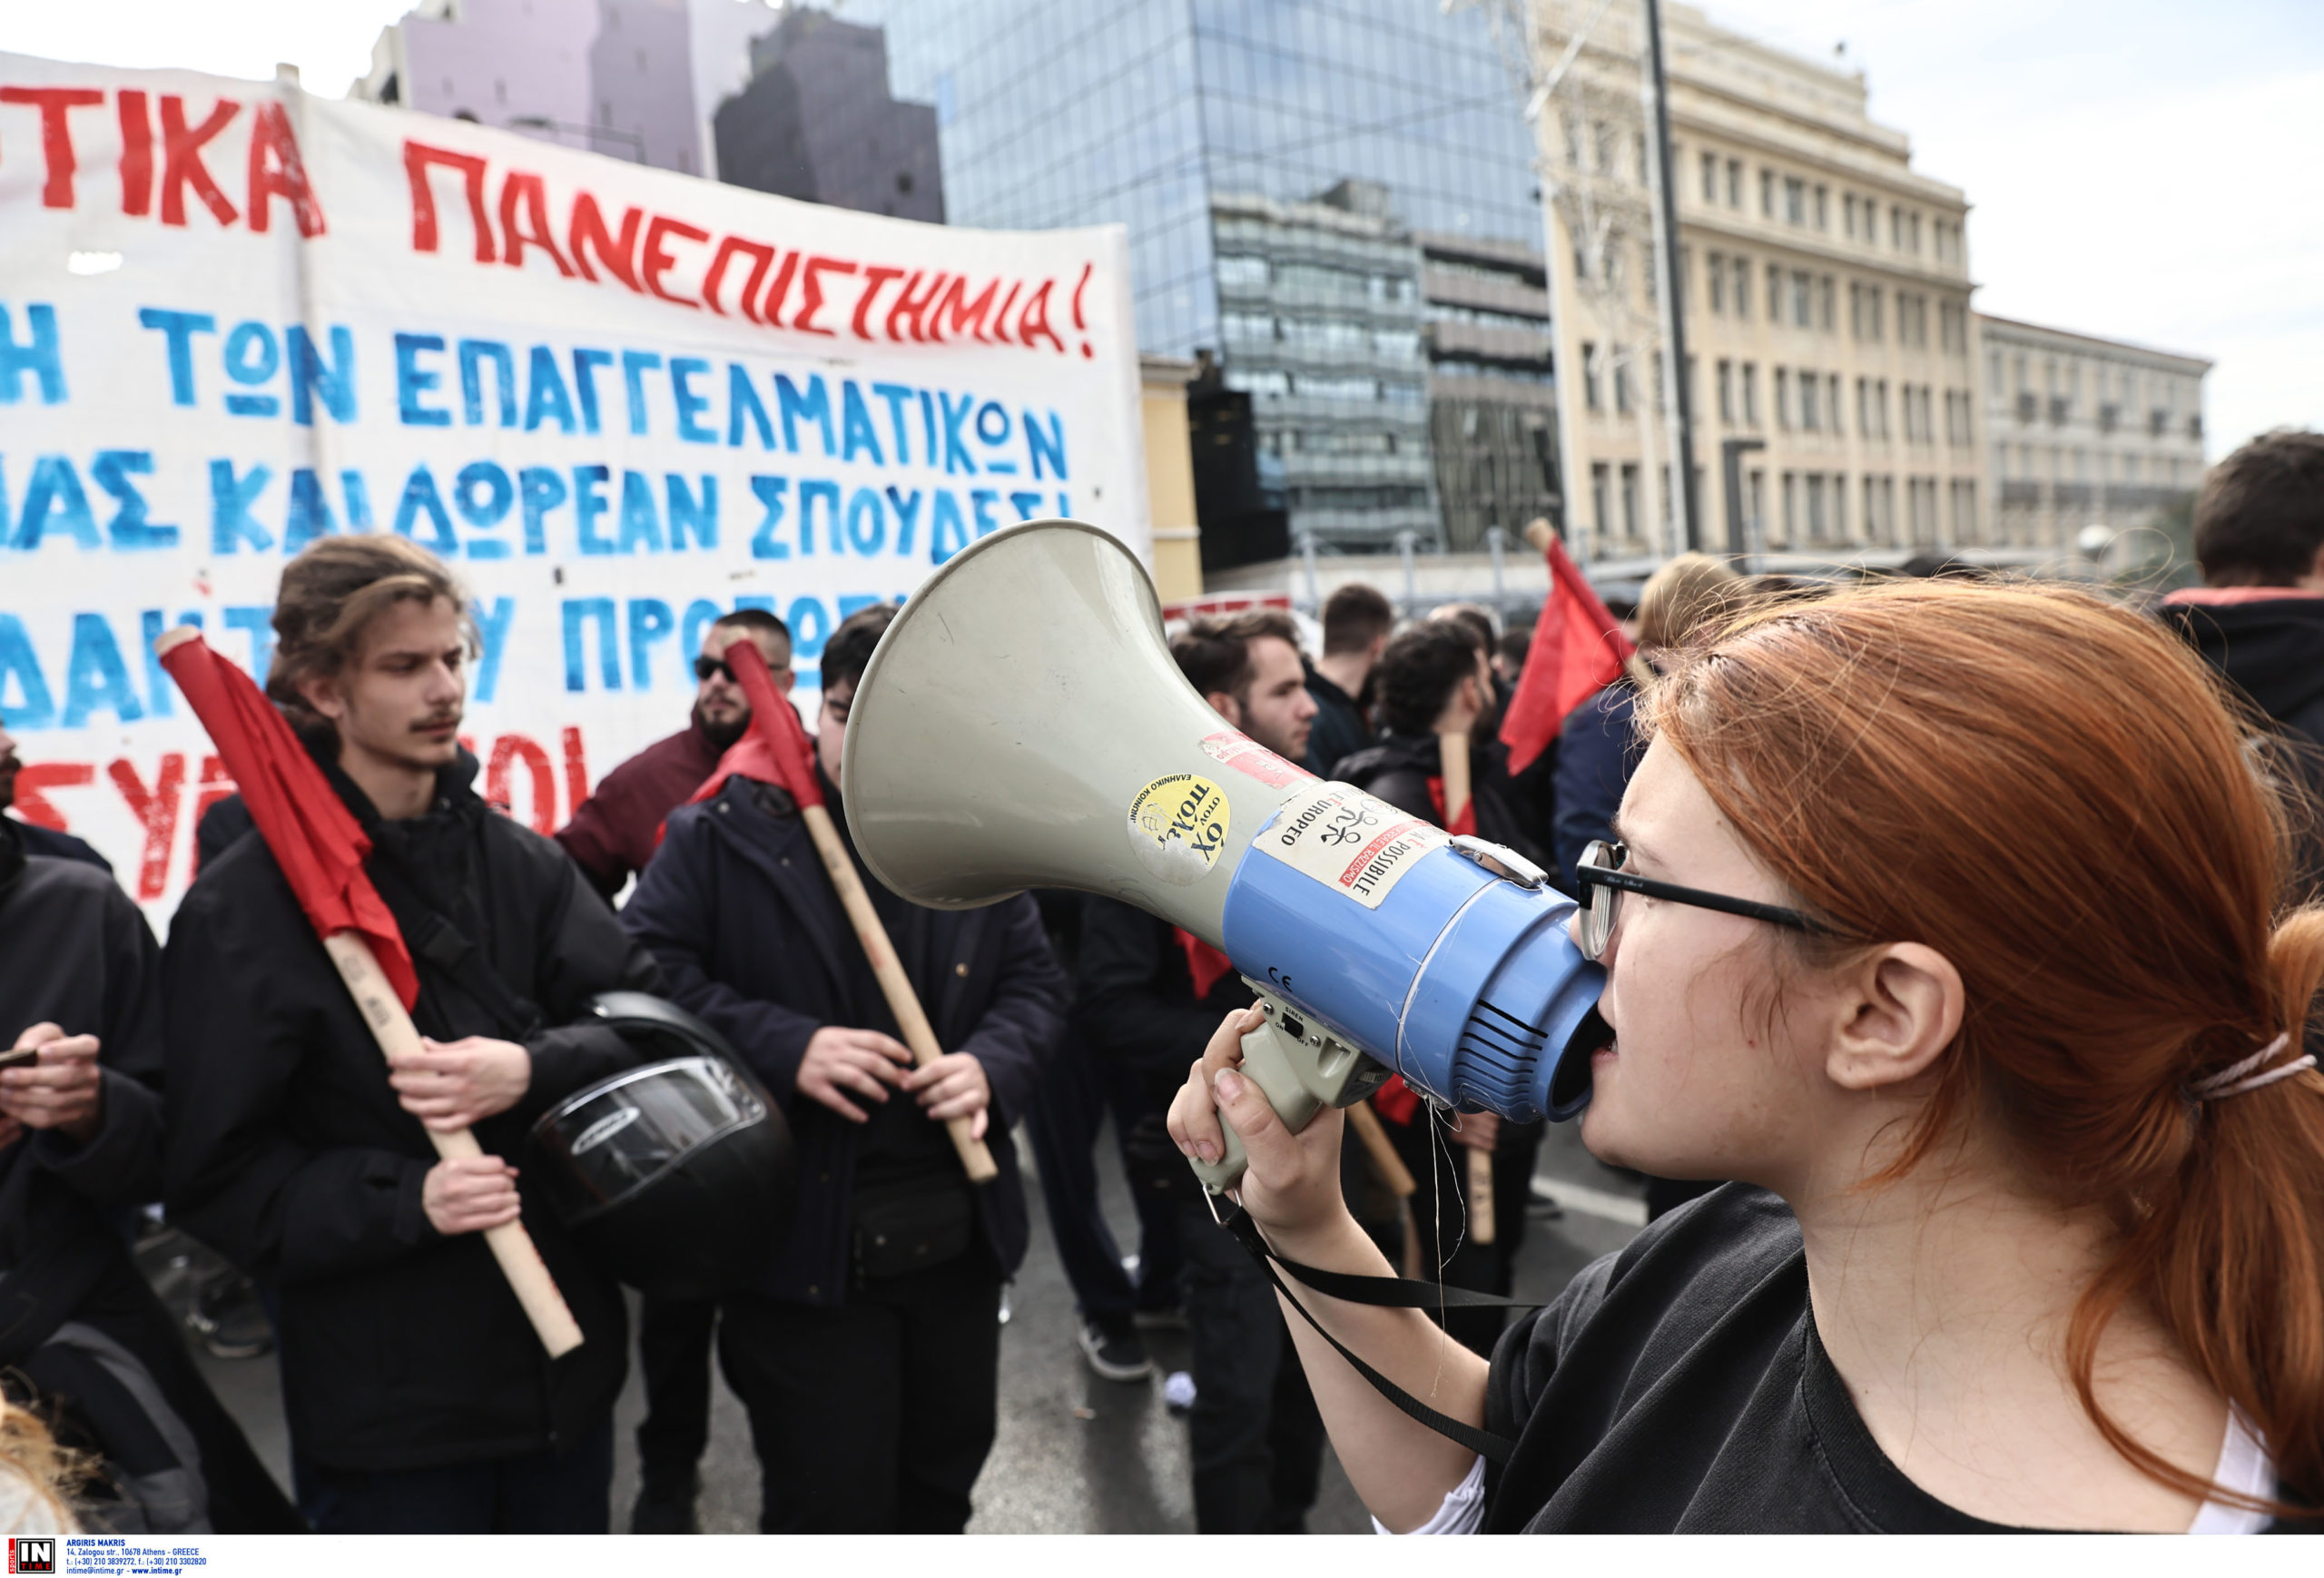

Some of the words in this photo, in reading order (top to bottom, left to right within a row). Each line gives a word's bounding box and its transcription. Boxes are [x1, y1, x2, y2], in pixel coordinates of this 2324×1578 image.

[403, 137, 1096, 360] ΠΑΝΕΠΙΣΤΗΜΙΑ!
[138, 305, 359, 427] ΤΩΝ
[394, 330, 1070, 481] ΕΠΑΓΓΕΛΜΑΤΙΚΩΝ
[0, 449, 179, 551] ΑΣ
[209, 459, 374, 556] ΚΑΙ
[392, 459, 719, 559] ΔΩΡΕΑΝ
[1150, 774, 1192, 791] ΕΛΛΗΝΙΚΟ
[1129, 788, 1151, 824] ΚΟΙΝΩΝΙ
[1281, 797, 1343, 846] EUROPEO
[1190, 822, 1225, 864] όχ
[1343, 849, 1375, 883] RAZZISMO
[1353, 840, 1412, 896] POSSIBILE
[1268, 966, 1292, 992] CE
[1275, 1021, 1285, 1031] ON
[1285, 1006, 1304, 1022] SIREN
[1296, 1038, 1309, 1047] OFF
